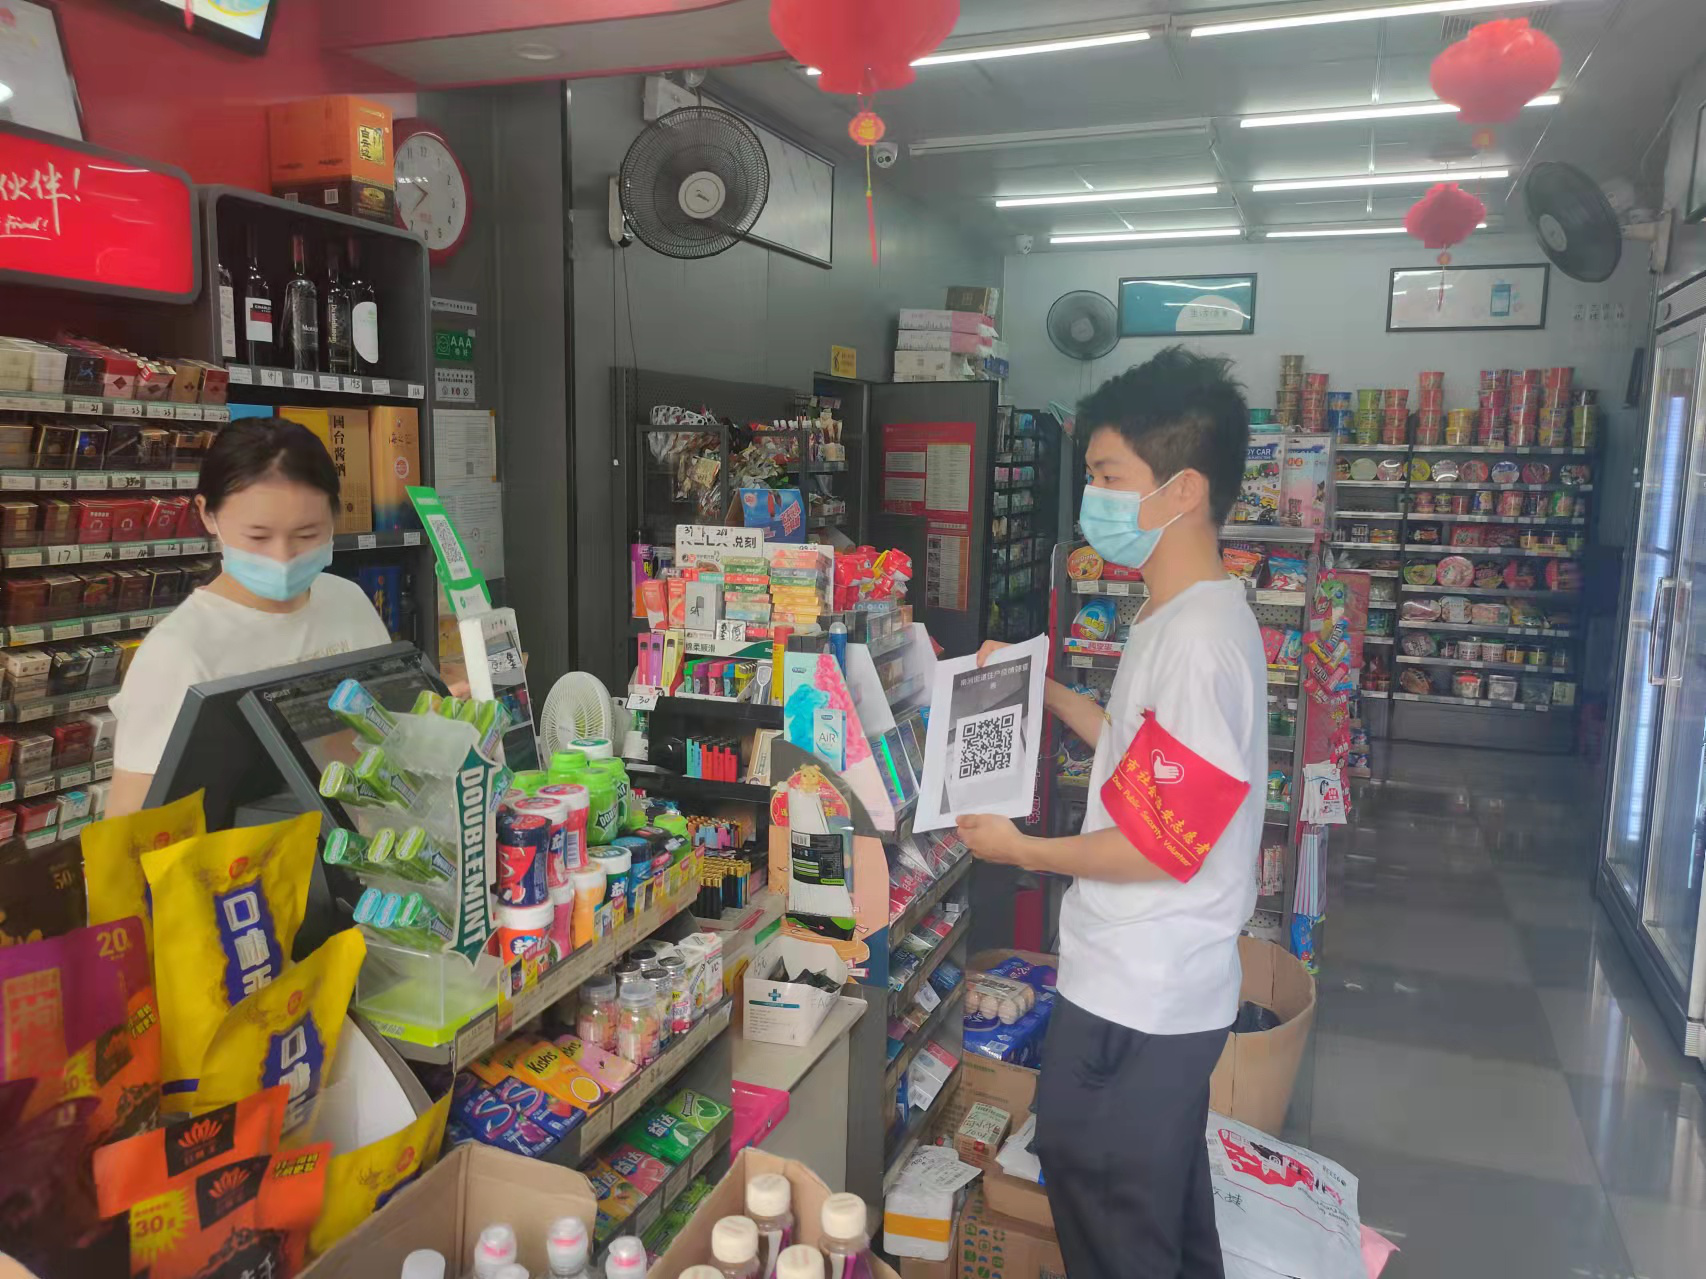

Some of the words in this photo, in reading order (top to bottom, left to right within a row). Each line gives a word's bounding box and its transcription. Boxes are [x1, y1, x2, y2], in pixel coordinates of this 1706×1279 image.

[450, 335, 472, 349] AAA
[1257, 448, 1271, 456] CAR
[57, 550, 72, 563] 17
[685, 643, 716, 653] 绵柔顺滑
[639, 695, 650, 705] 30
[1140, 810, 1163, 840] Security
[1162, 839, 1193, 867] Volunteer
[461, 763, 488, 947] DOUBLEMINT
[647, 1113, 678, 1138] 益达
[613, 1151, 645, 1176] 益达
